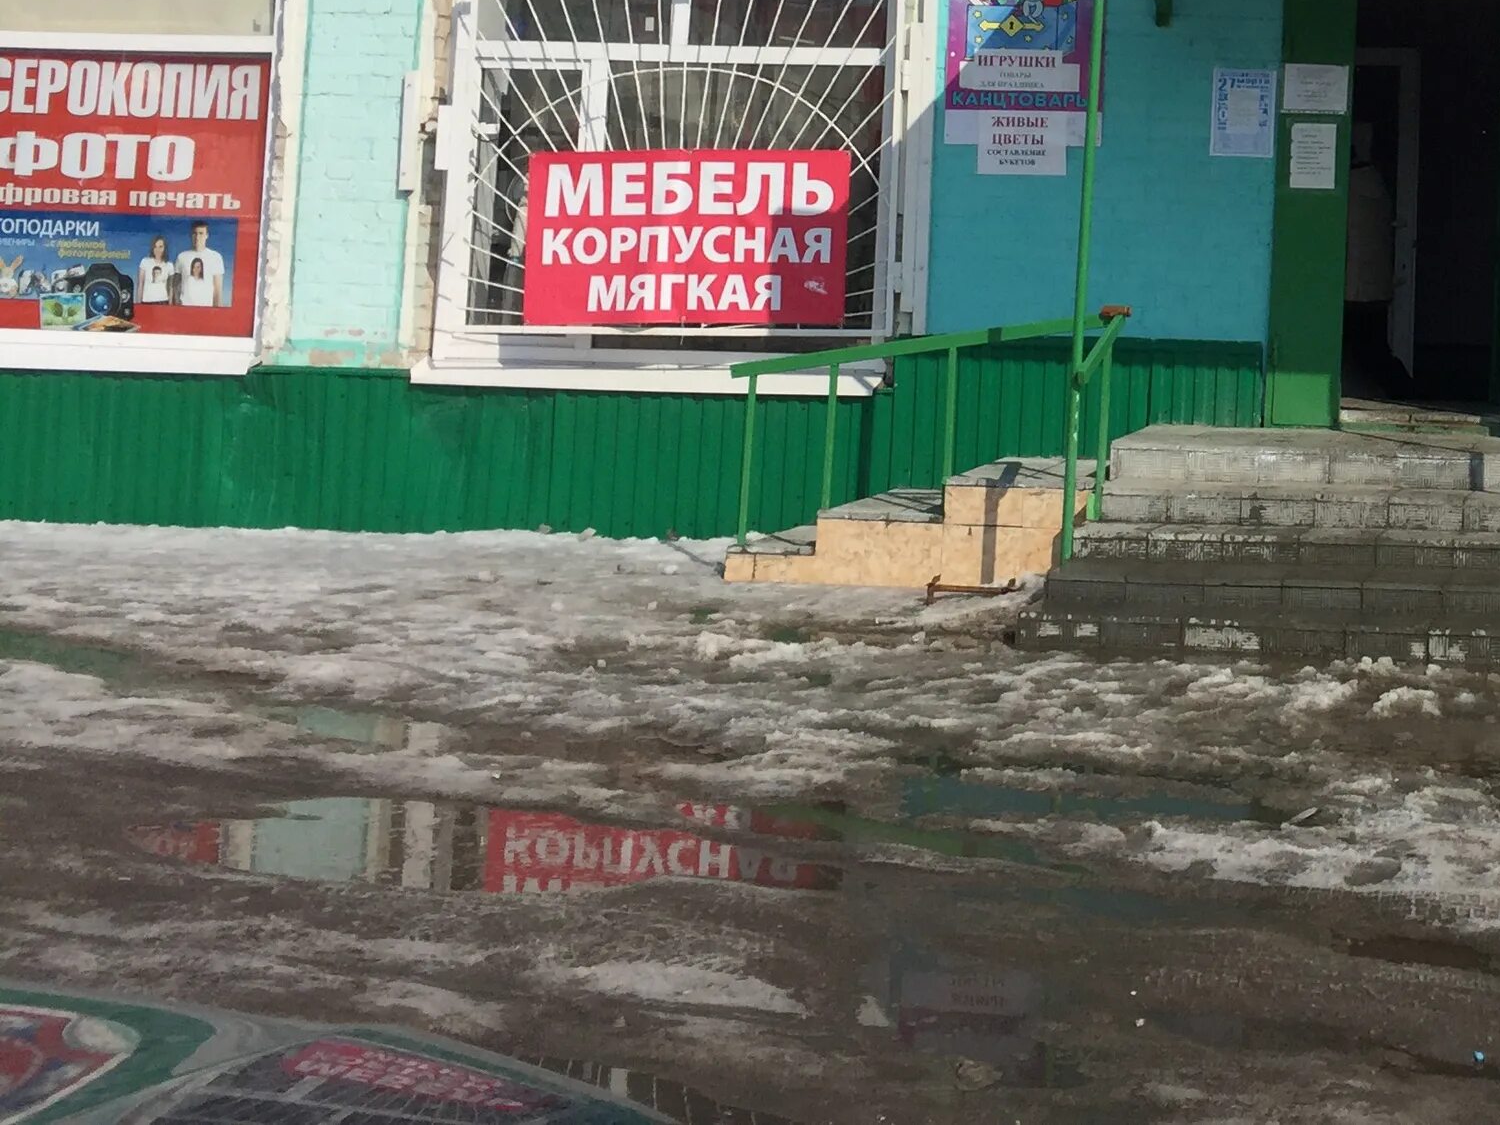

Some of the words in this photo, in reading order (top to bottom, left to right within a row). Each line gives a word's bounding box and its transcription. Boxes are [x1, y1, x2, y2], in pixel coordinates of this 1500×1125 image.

[977, 54, 1056, 69] ИГРУШКИ
[991, 115, 1049, 129] ЖИВЫЕ
[992, 133, 1044, 147] ЦВЕТЫ
[544, 161, 835, 218] МЕБЕЛЬ
[129, 190, 241, 210] печать
[541, 225, 832, 265] КОРПУСНАЯ
[587, 274, 782, 312] МЯГКАЯ
